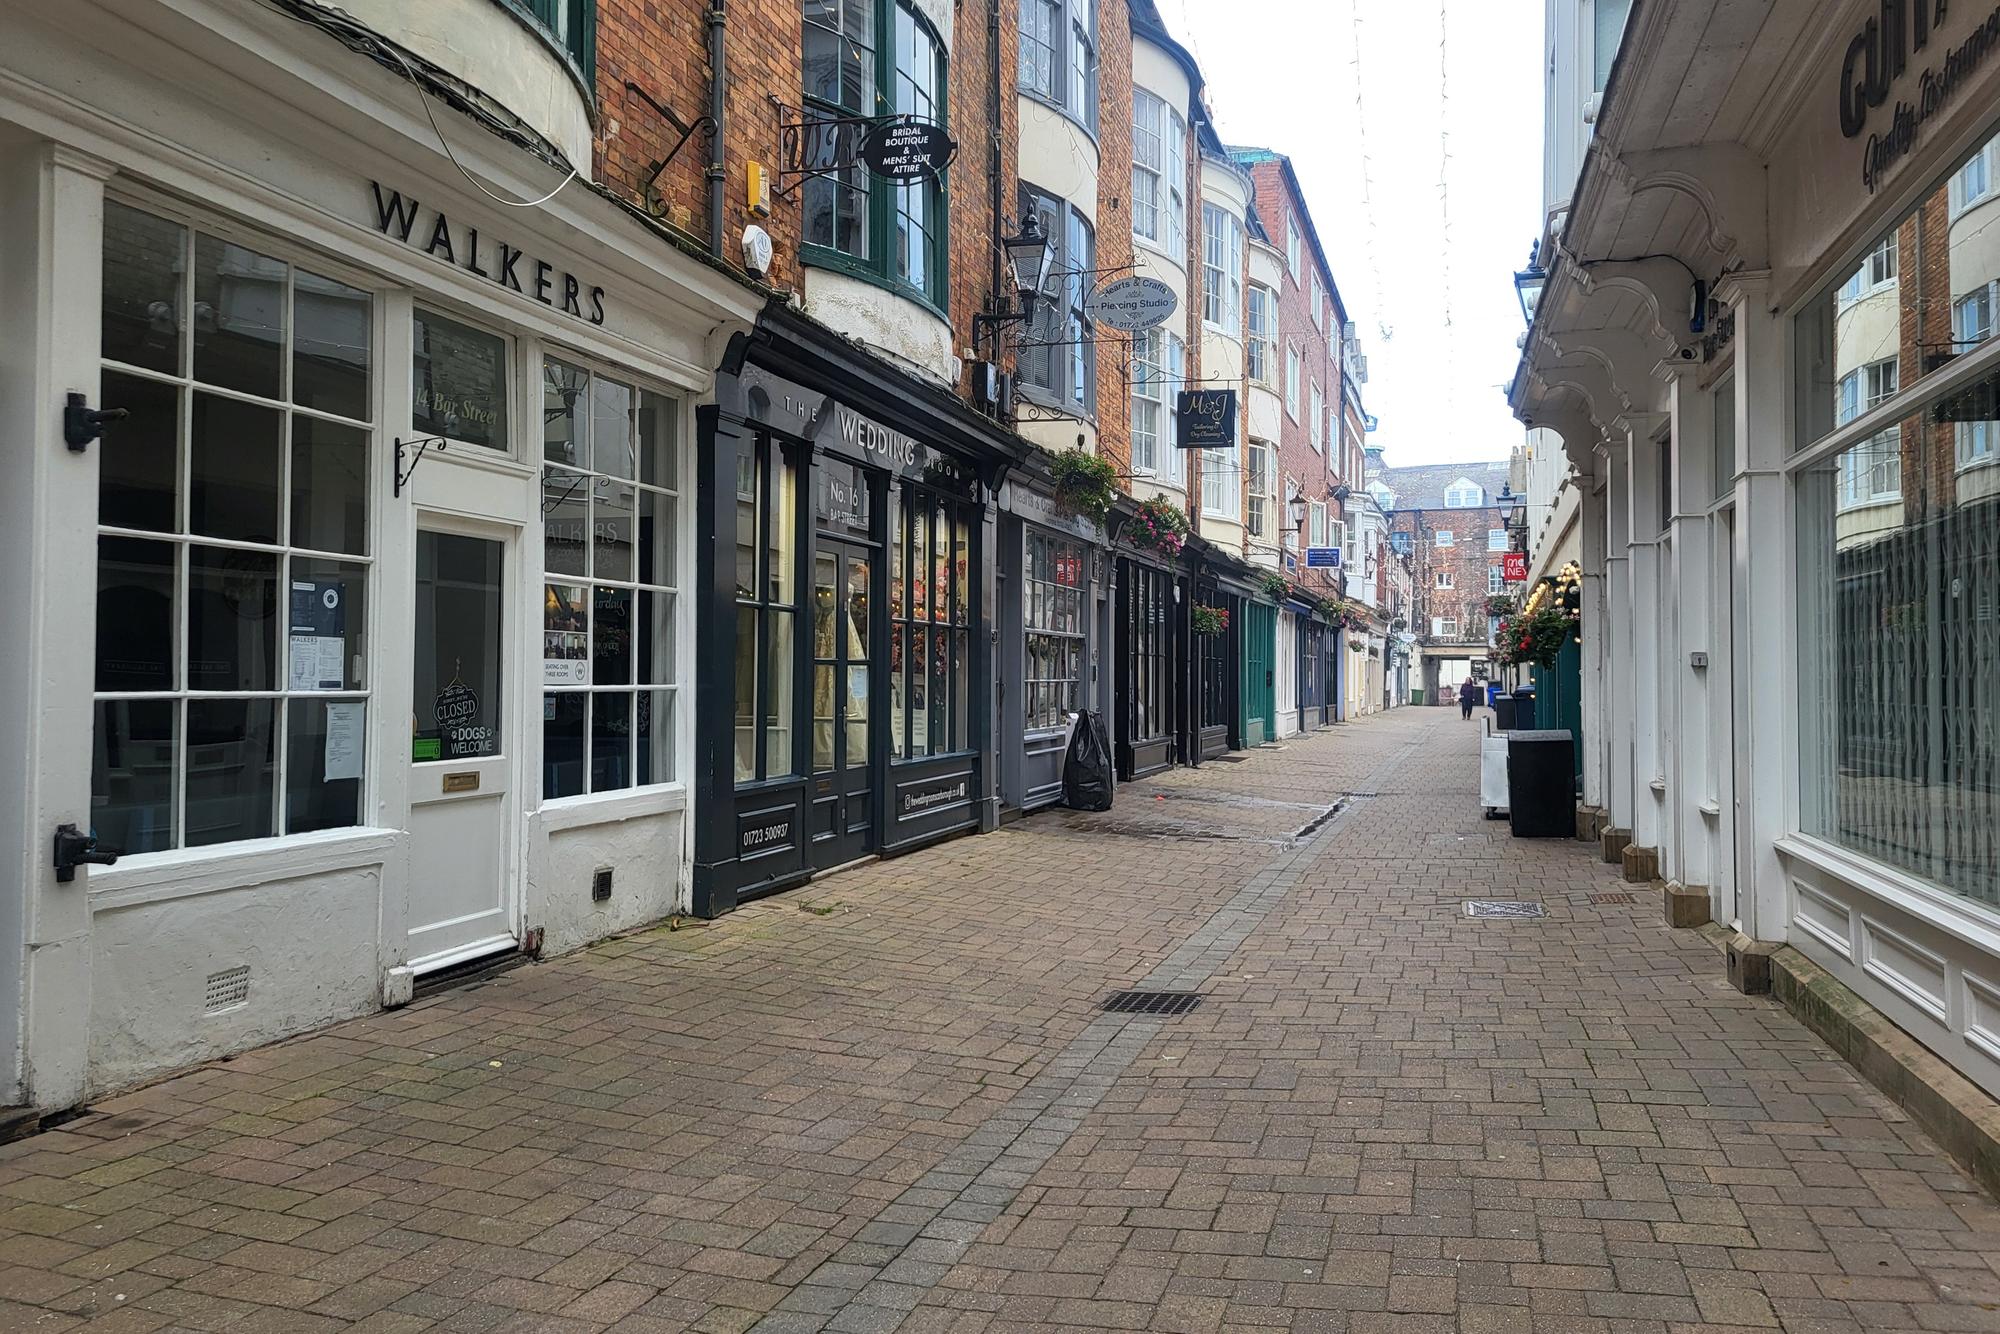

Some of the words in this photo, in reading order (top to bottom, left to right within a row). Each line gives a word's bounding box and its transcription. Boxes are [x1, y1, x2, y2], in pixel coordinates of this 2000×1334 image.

[892, 127, 922, 137] BRIDAL
[885, 136, 929, 147] BOUTIQUE
[903, 146, 910, 155] &
[882, 155, 910, 166] MENS'
[912, 153, 931, 163] SUIT
[892, 164, 920, 174] ATTIRE
[371, 181, 605, 326] WALKERS
[1102, 281, 1130, 298] Hearts
[1142, 280, 1167, 295] Crafts
[1101, 302, 1137, 311] Piercing
[1139, 299, 1169, 308] Studio
[434, 392, 458, 413] Bar
[462, 400, 497, 425] Street
[1183, 394, 1228, 421] M&J
[784, 396, 817, 422] THE
[839, 411, 915, 466] WEDDING
[928, 457, 960, 480] ROOM
[831, 481, 845, 503] No.
[850, 487, 858, 507] 16
[437, 700, 475, 720] CLOSED
[458, 727, 486, 741] DOGS
[451, 740, 493, 755] WELCOME
[743, 829, 763, 847] 01723
[764, 823, 789, 842] 500937
